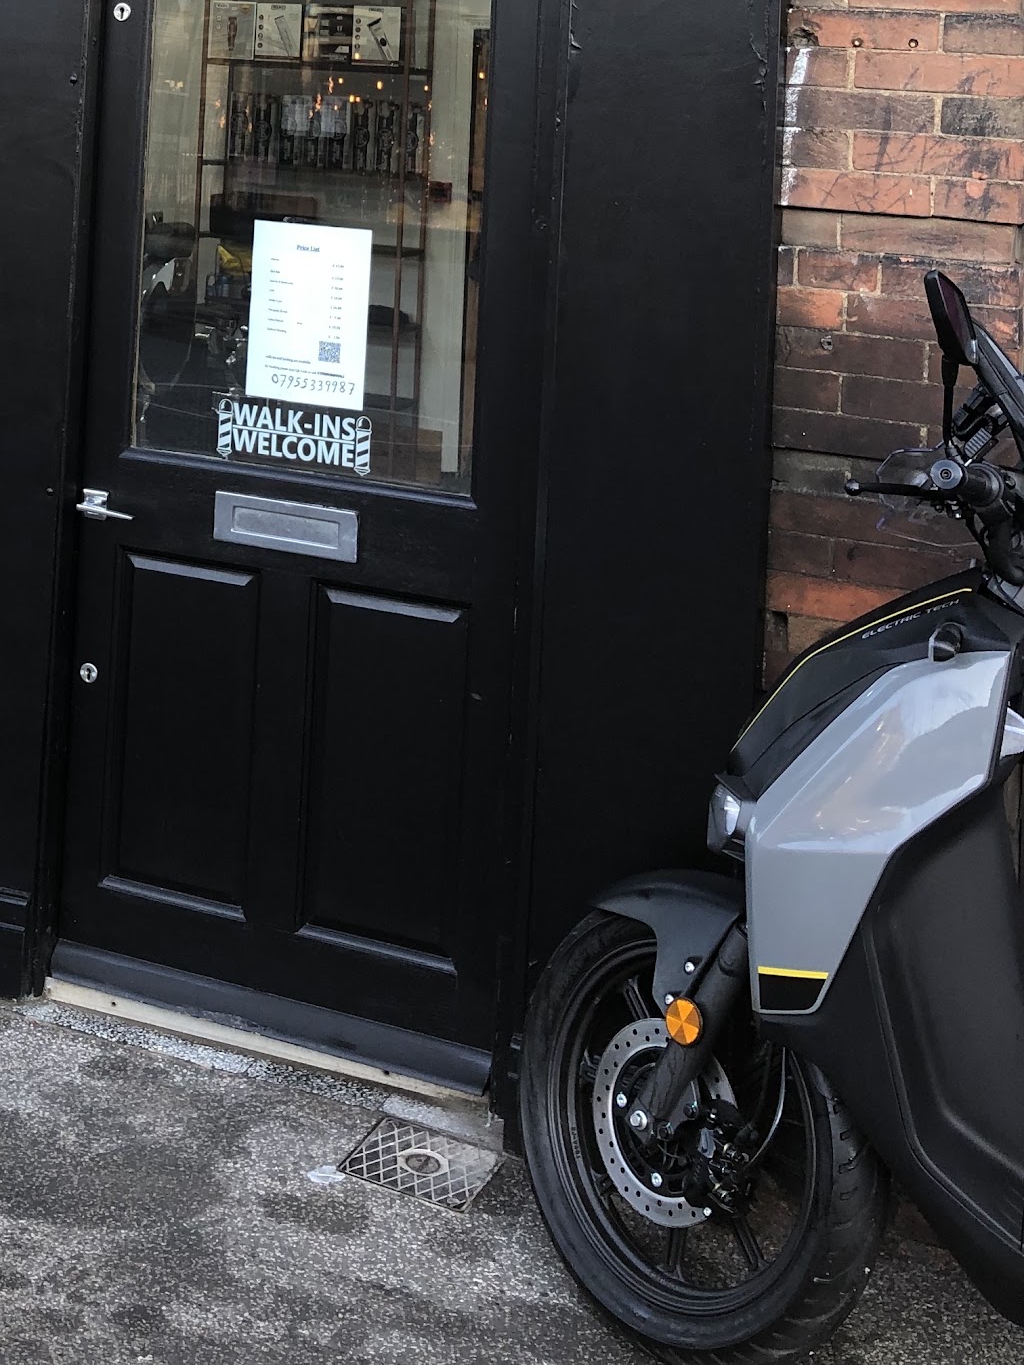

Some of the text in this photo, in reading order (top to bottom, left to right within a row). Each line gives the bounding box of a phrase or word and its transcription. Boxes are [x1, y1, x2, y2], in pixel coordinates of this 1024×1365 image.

[296, 244, 310, 252] Price
[271, 373, 356, 395] 07955339987
[232, 402, 356, 441] WALK-INS
[232, 429, 355, 468] WELCOME
[861, 599, 960, 640] ELECTRIC TECH
